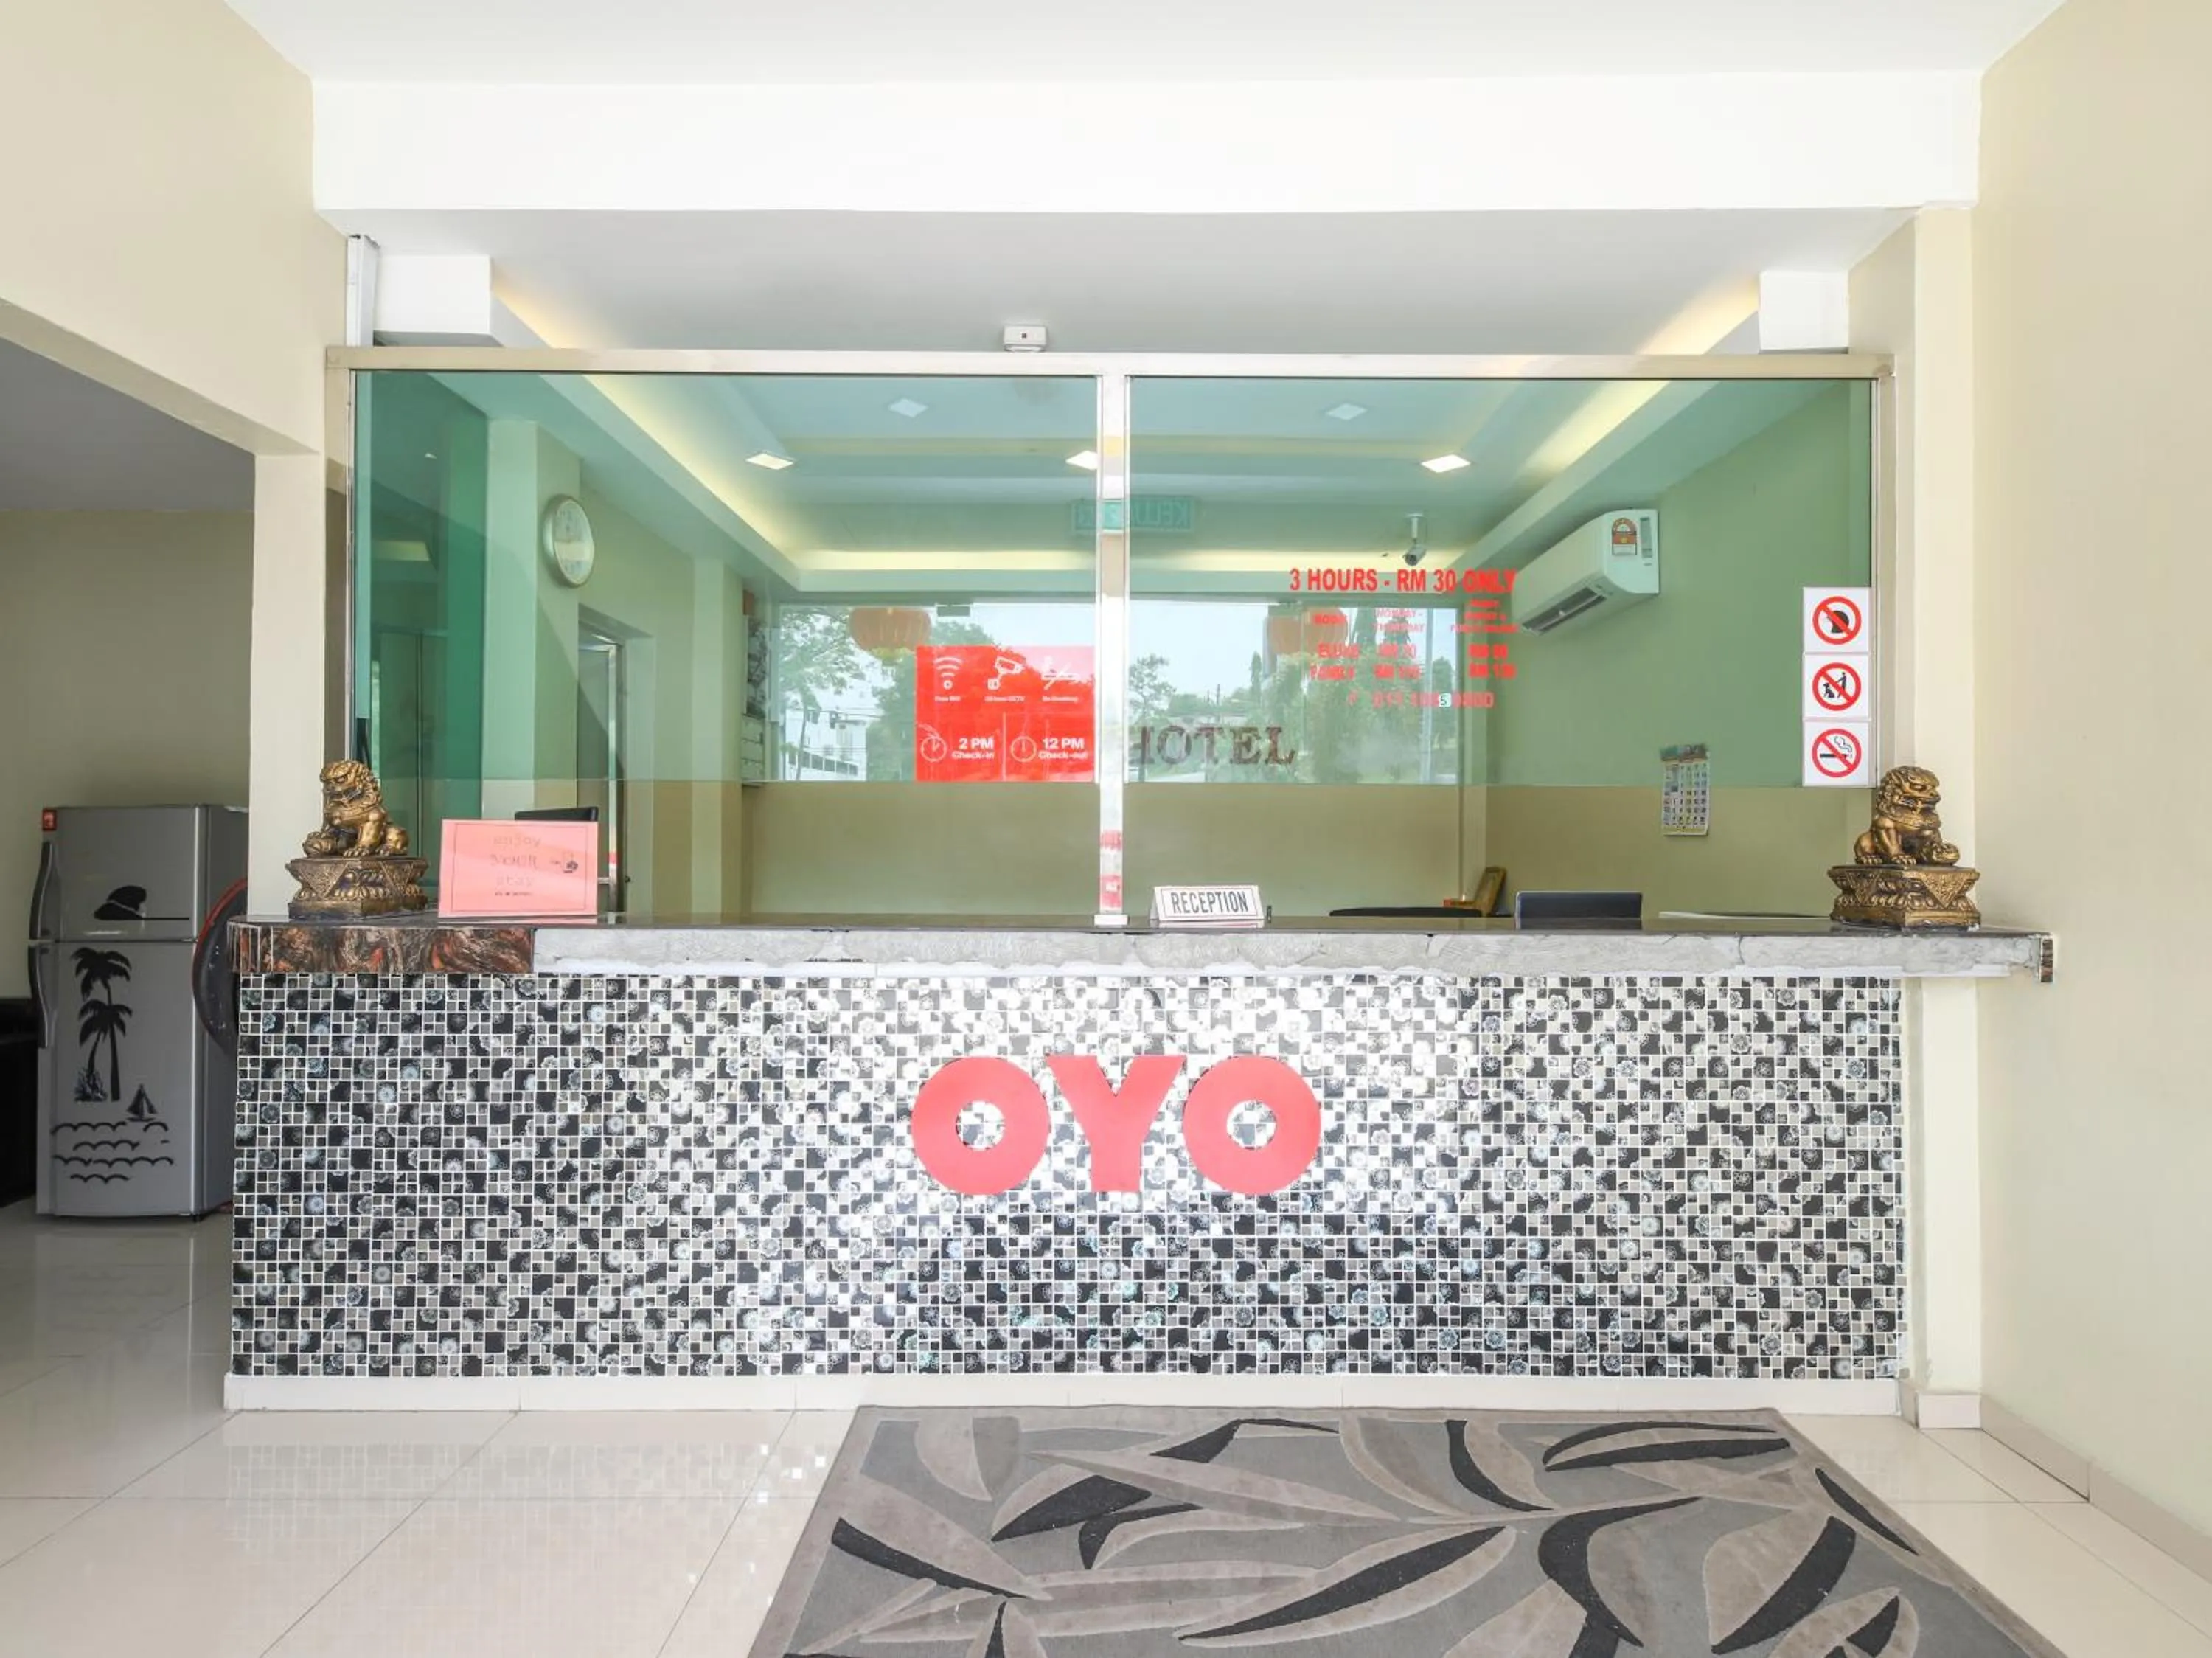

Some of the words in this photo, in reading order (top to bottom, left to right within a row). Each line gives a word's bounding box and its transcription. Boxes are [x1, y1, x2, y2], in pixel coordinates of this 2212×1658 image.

[1290, 568, 1301, 591] 3
[1307, 568, 1378, 592] HOURS
[1397, 569, 1427, 592] RM
[1433, 569, 1457, 593] 30
[1462, 569, 1517, 593] ONLY
[959, 738, 968, 750] 2
[971, 738, 994, 750] PM
[1043, 738, 1059, 750] 12
[1062, 738, 1085, 750] PM
[1129, 725, 1295, 765] HOTEL
[1170, 890, 1248, 914] RECEPTION
[911, 1054, 1321, 1196] OYO
